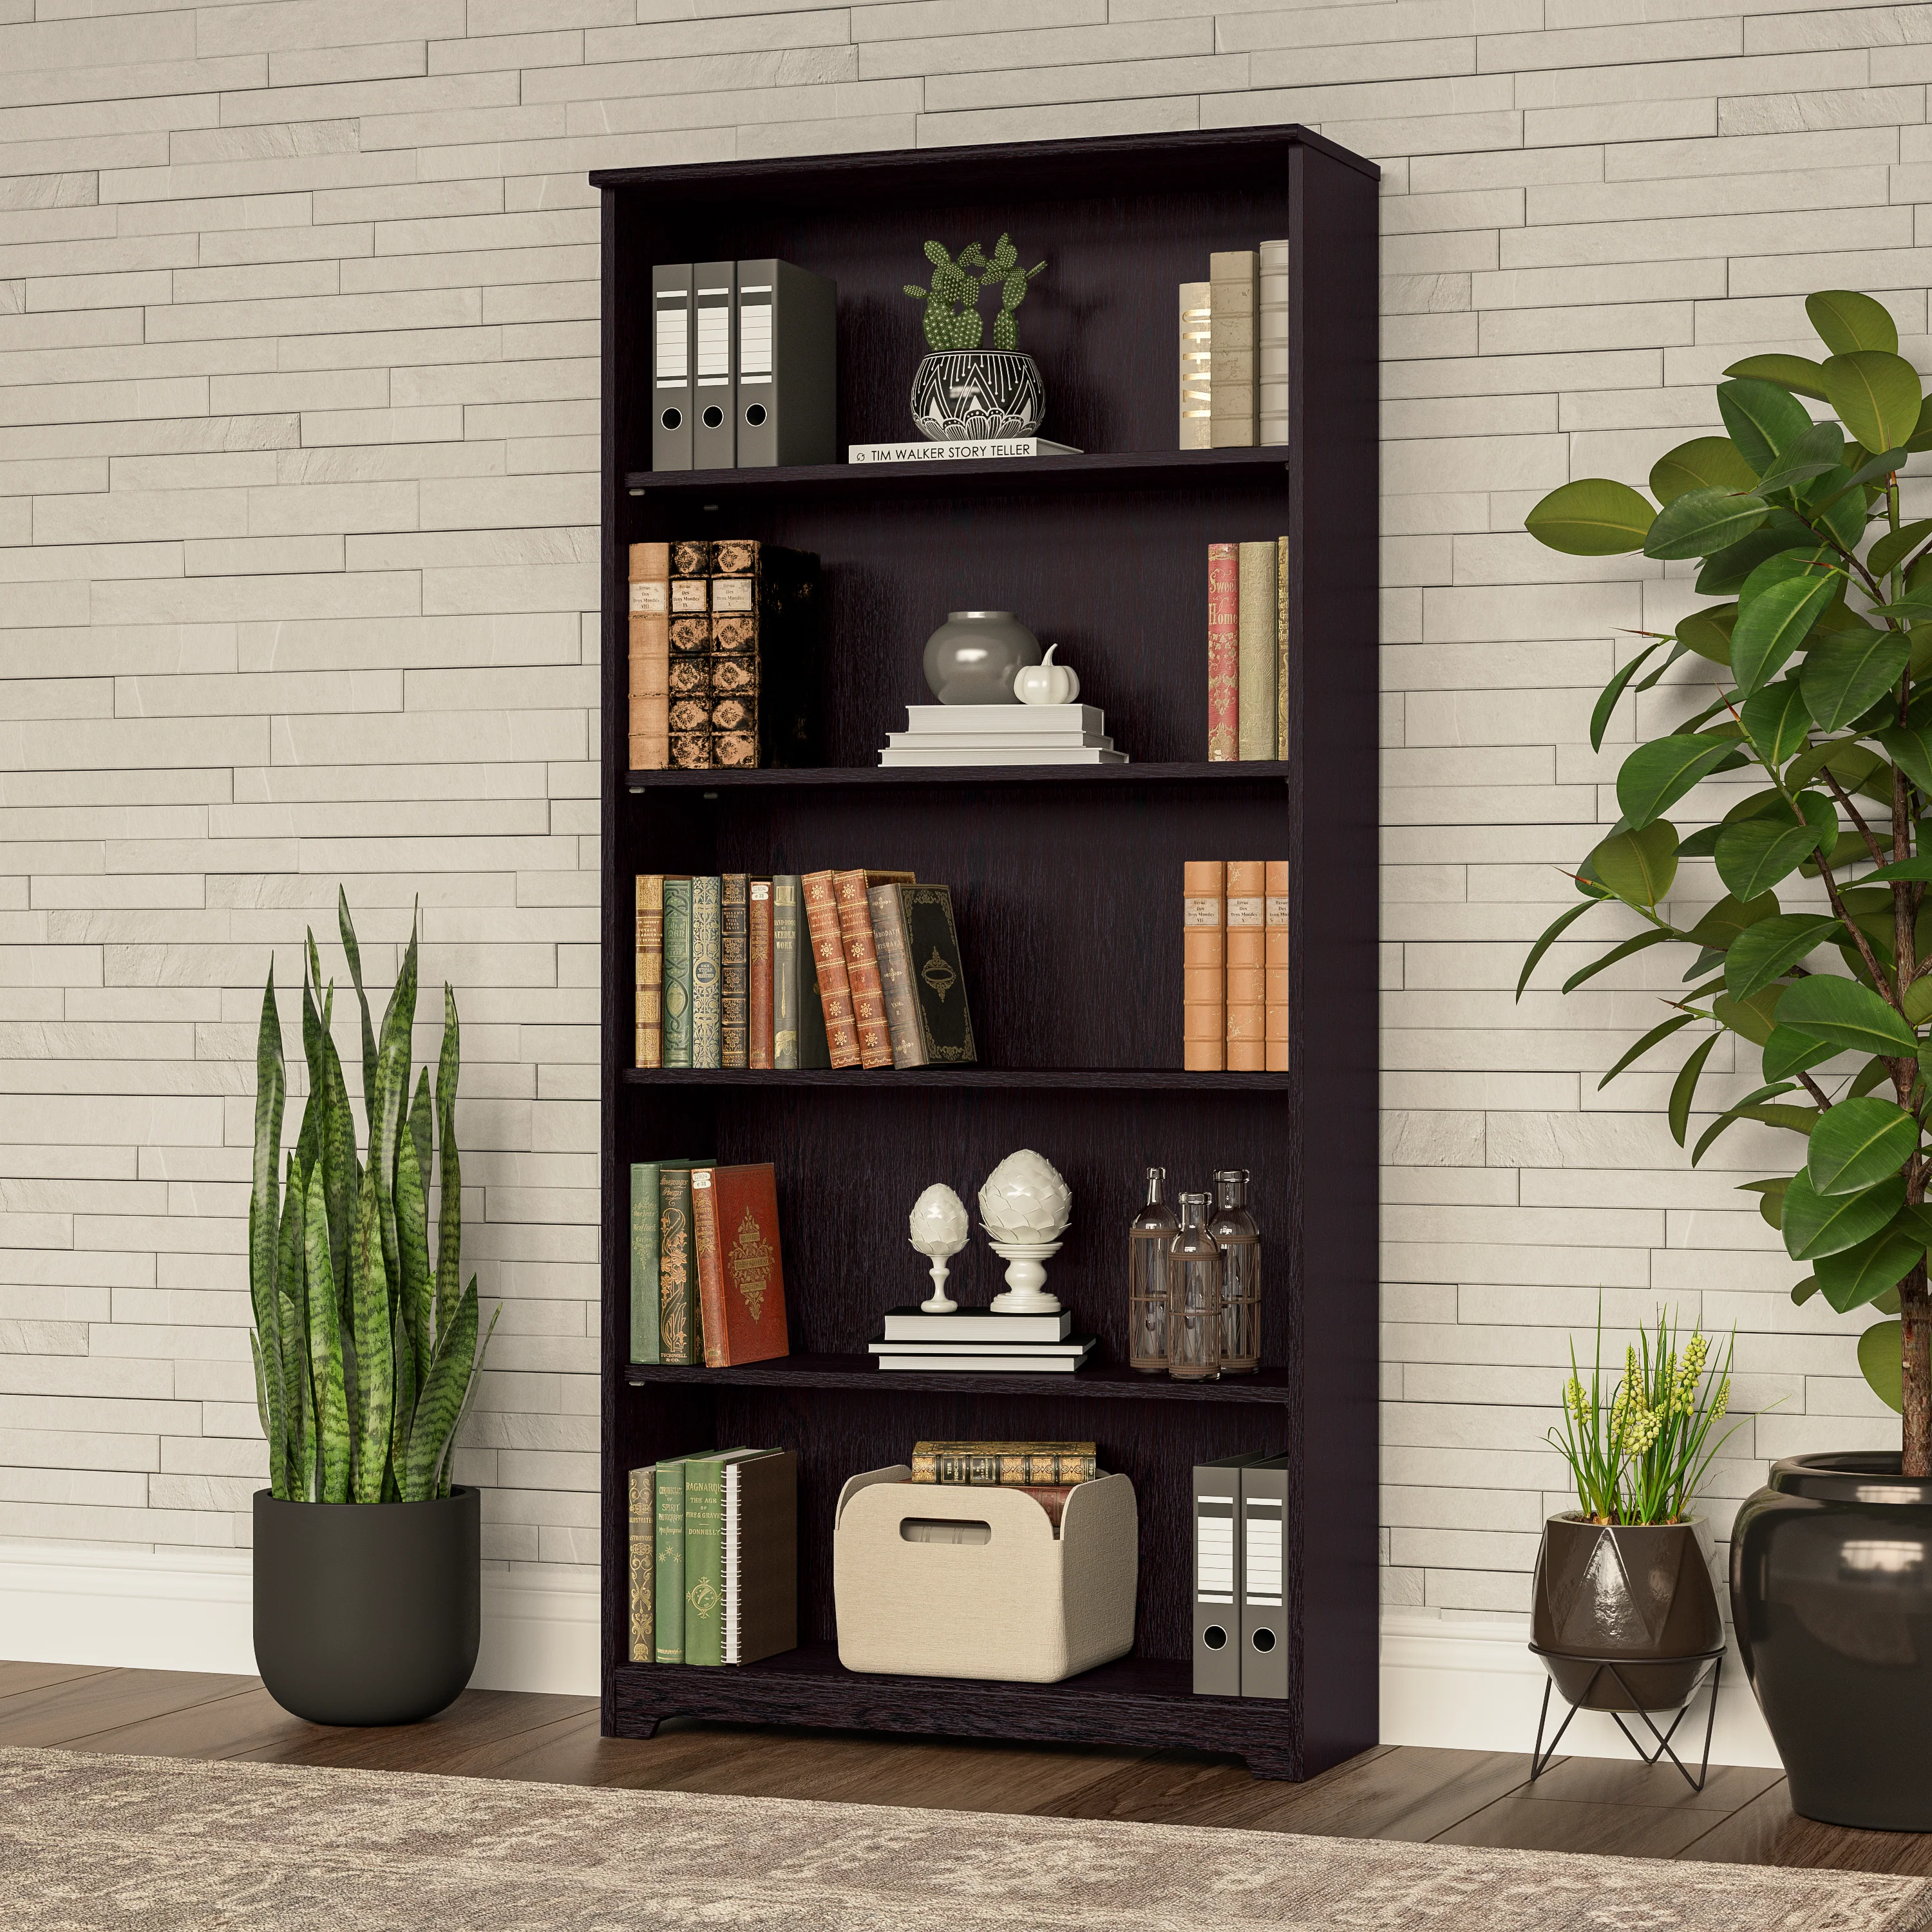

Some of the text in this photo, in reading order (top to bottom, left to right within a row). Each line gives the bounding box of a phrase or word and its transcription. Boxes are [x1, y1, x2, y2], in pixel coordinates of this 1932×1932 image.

[871, 444, 1030, 461] TIM WALKER STORY TELLER
[1209, 569, 1237, 592] Sweet
[1209, 598, 1238, 625] Home
[662, 1188, 683, 1196] Poems
[662, 1503, 680, 1513] SPIRIT
